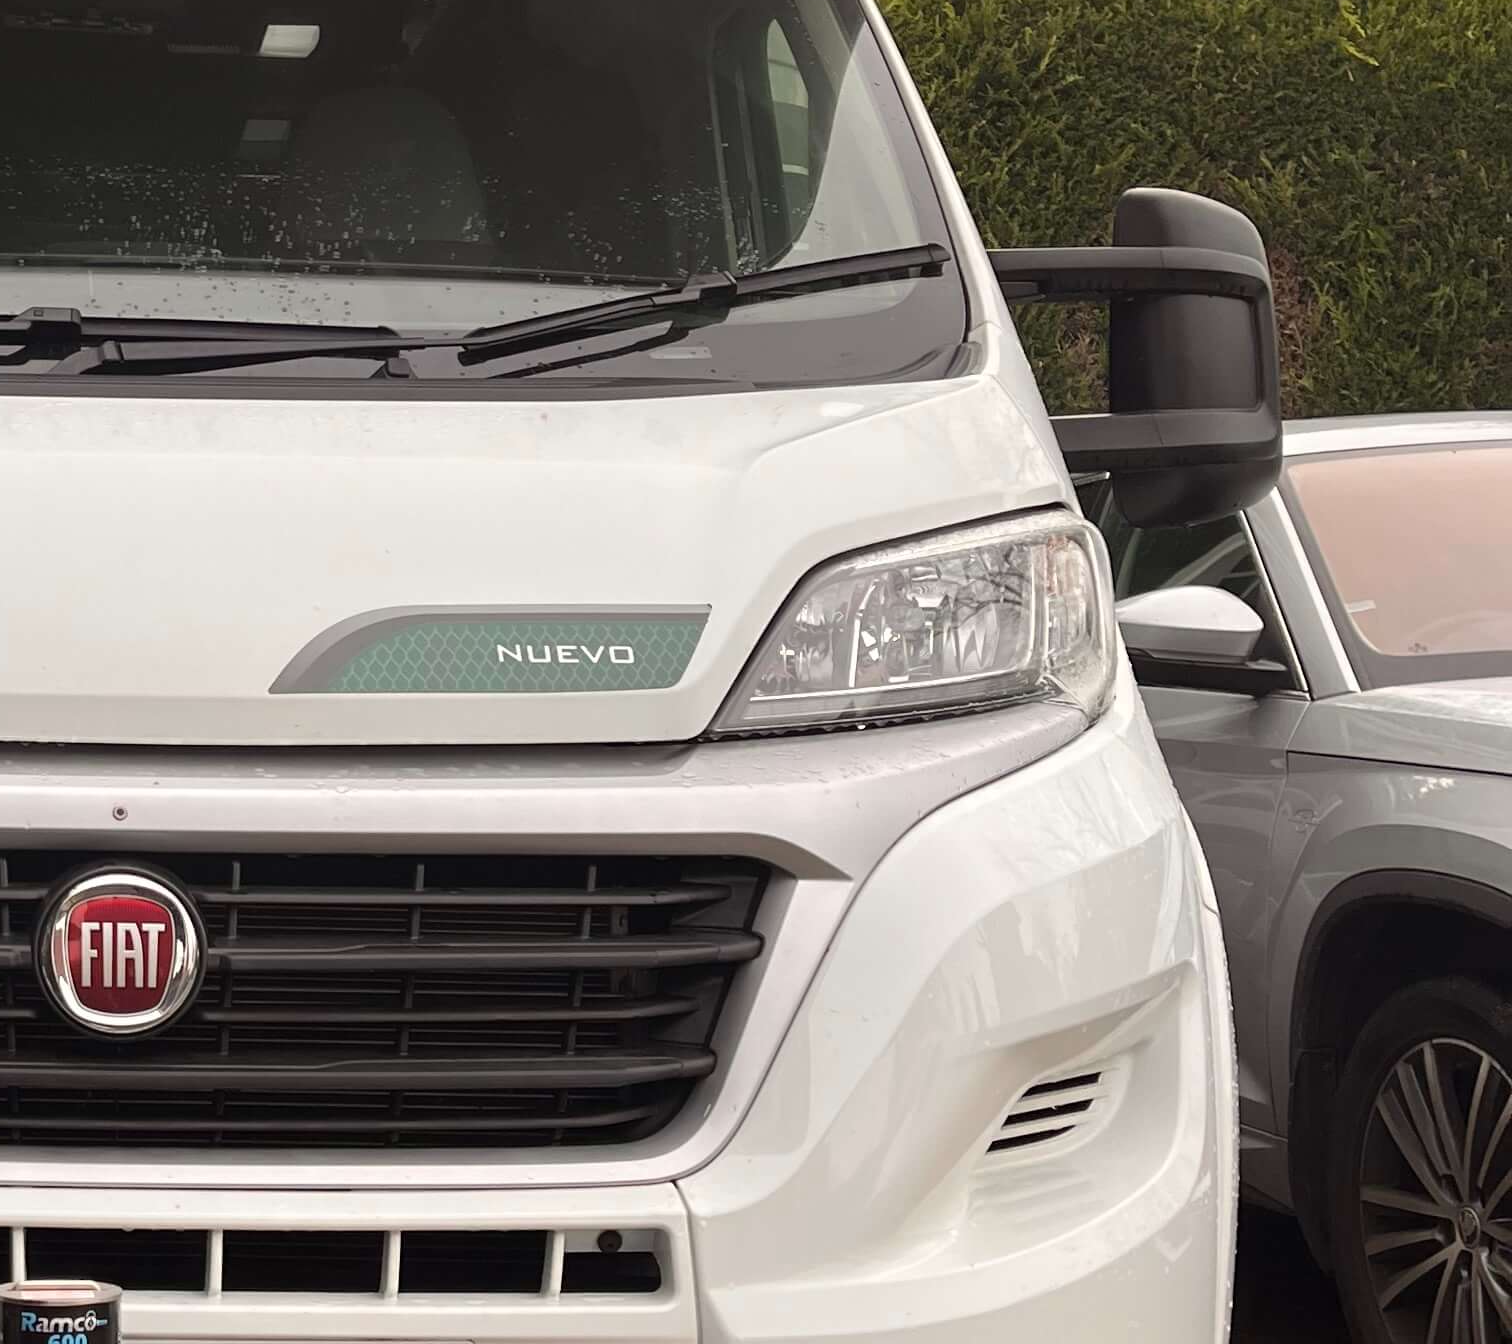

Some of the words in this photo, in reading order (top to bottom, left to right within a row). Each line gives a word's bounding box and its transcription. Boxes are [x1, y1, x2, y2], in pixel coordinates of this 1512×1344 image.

[496, 643, 635, 665] NUEVO
[80, 921, 167, 989] FIAT
[20, 1311, 97, 1334] Ramco
